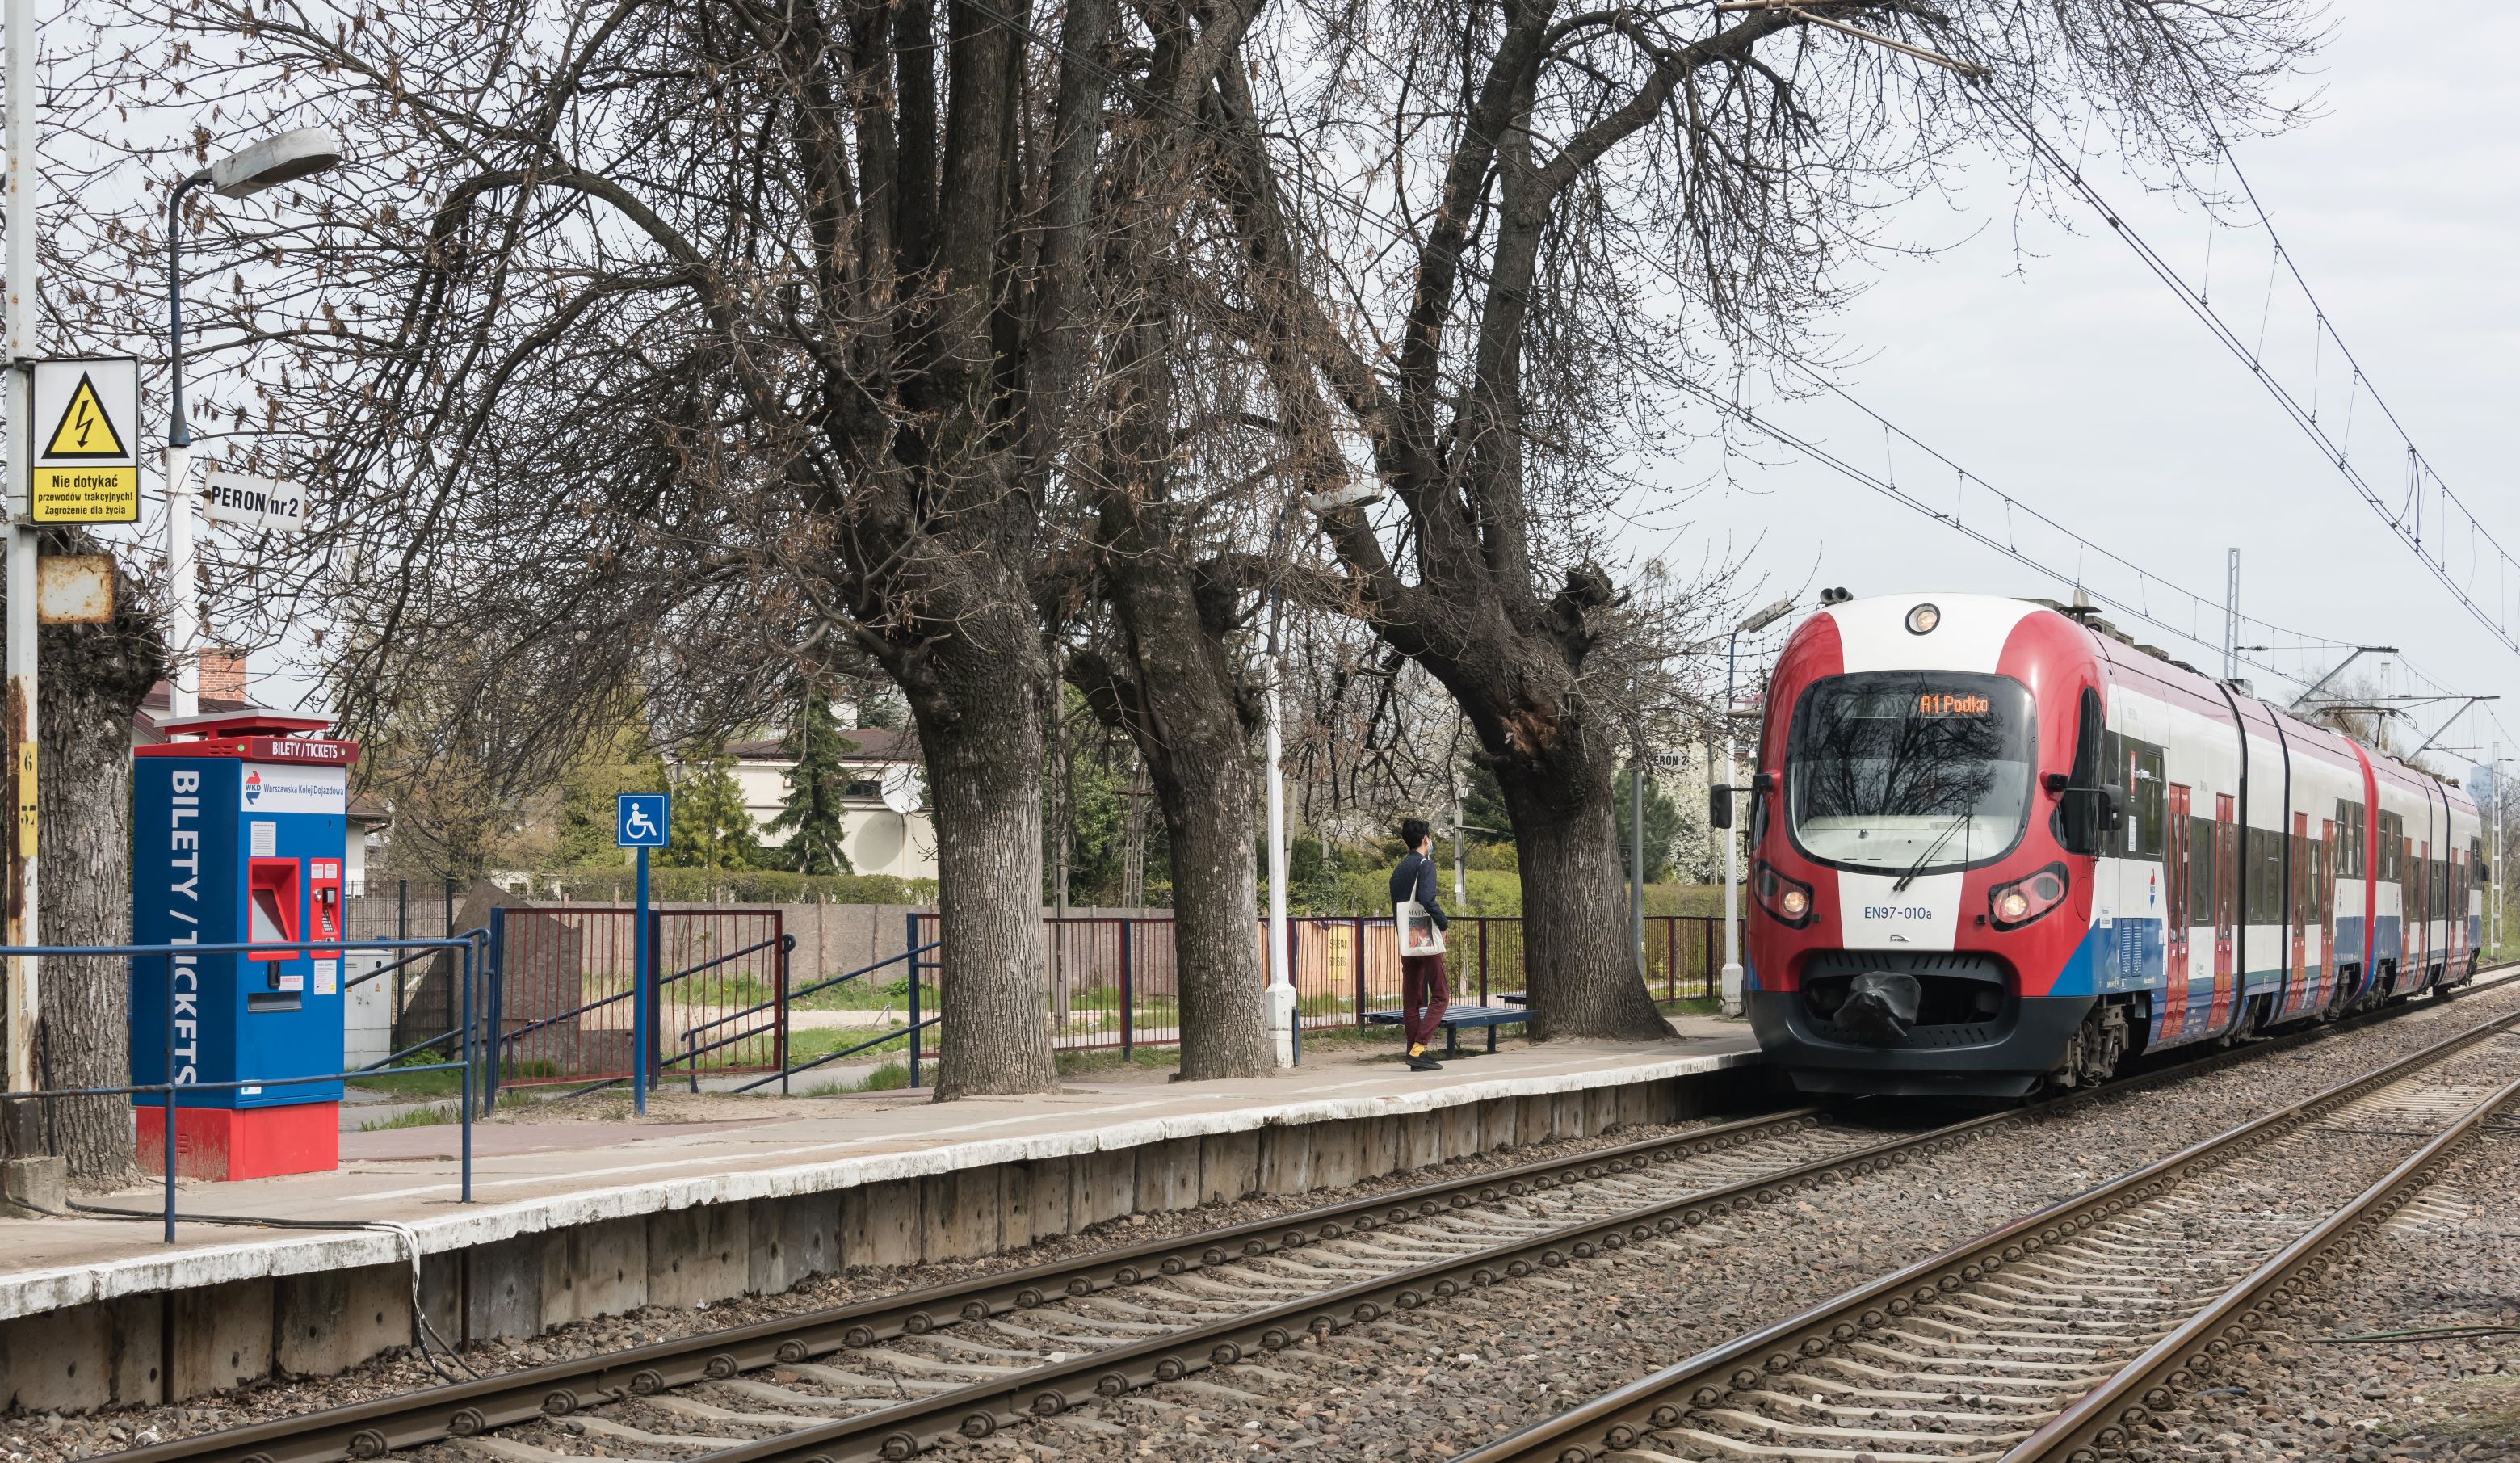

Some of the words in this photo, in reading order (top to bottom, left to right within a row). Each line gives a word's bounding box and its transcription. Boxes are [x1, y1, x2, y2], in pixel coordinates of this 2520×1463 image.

[52, 475, 70, 487] Nie
[74, 474, 118, 490] dotykać
[38, 492, 81, 502] przewodów
[84, 492, 132, 502] trakcyjnych!
[211, 486, 266, 512] PERON
[270, 499, 287, 515] nr
[288, 498, 299, 517] 2
[45, 505, 88, 516] Zagrożenie
[90, 506, 103, 515] dla
[106, 506, 126, 515] życia
[1921, 694, 1938, 713] A1
[272, 741, 300, 756] BILETY
[305, 743, 338, 758] TICKETS
[24, 751, 32, 771] 6
[1653, 755, 1678, 766] ERON
[1681, 755, 1687, 766] 2
[263, 784, 298, 793] Warszawska
[298, 785, 313, 796] Kolej
[313, 785, 344, 797] Dojazdowa
[171, 771, 200, 902] BILETY
[1864, 906, 1932, 919] EN97-010a
[170, 931, 198, 1084] TICKETS
